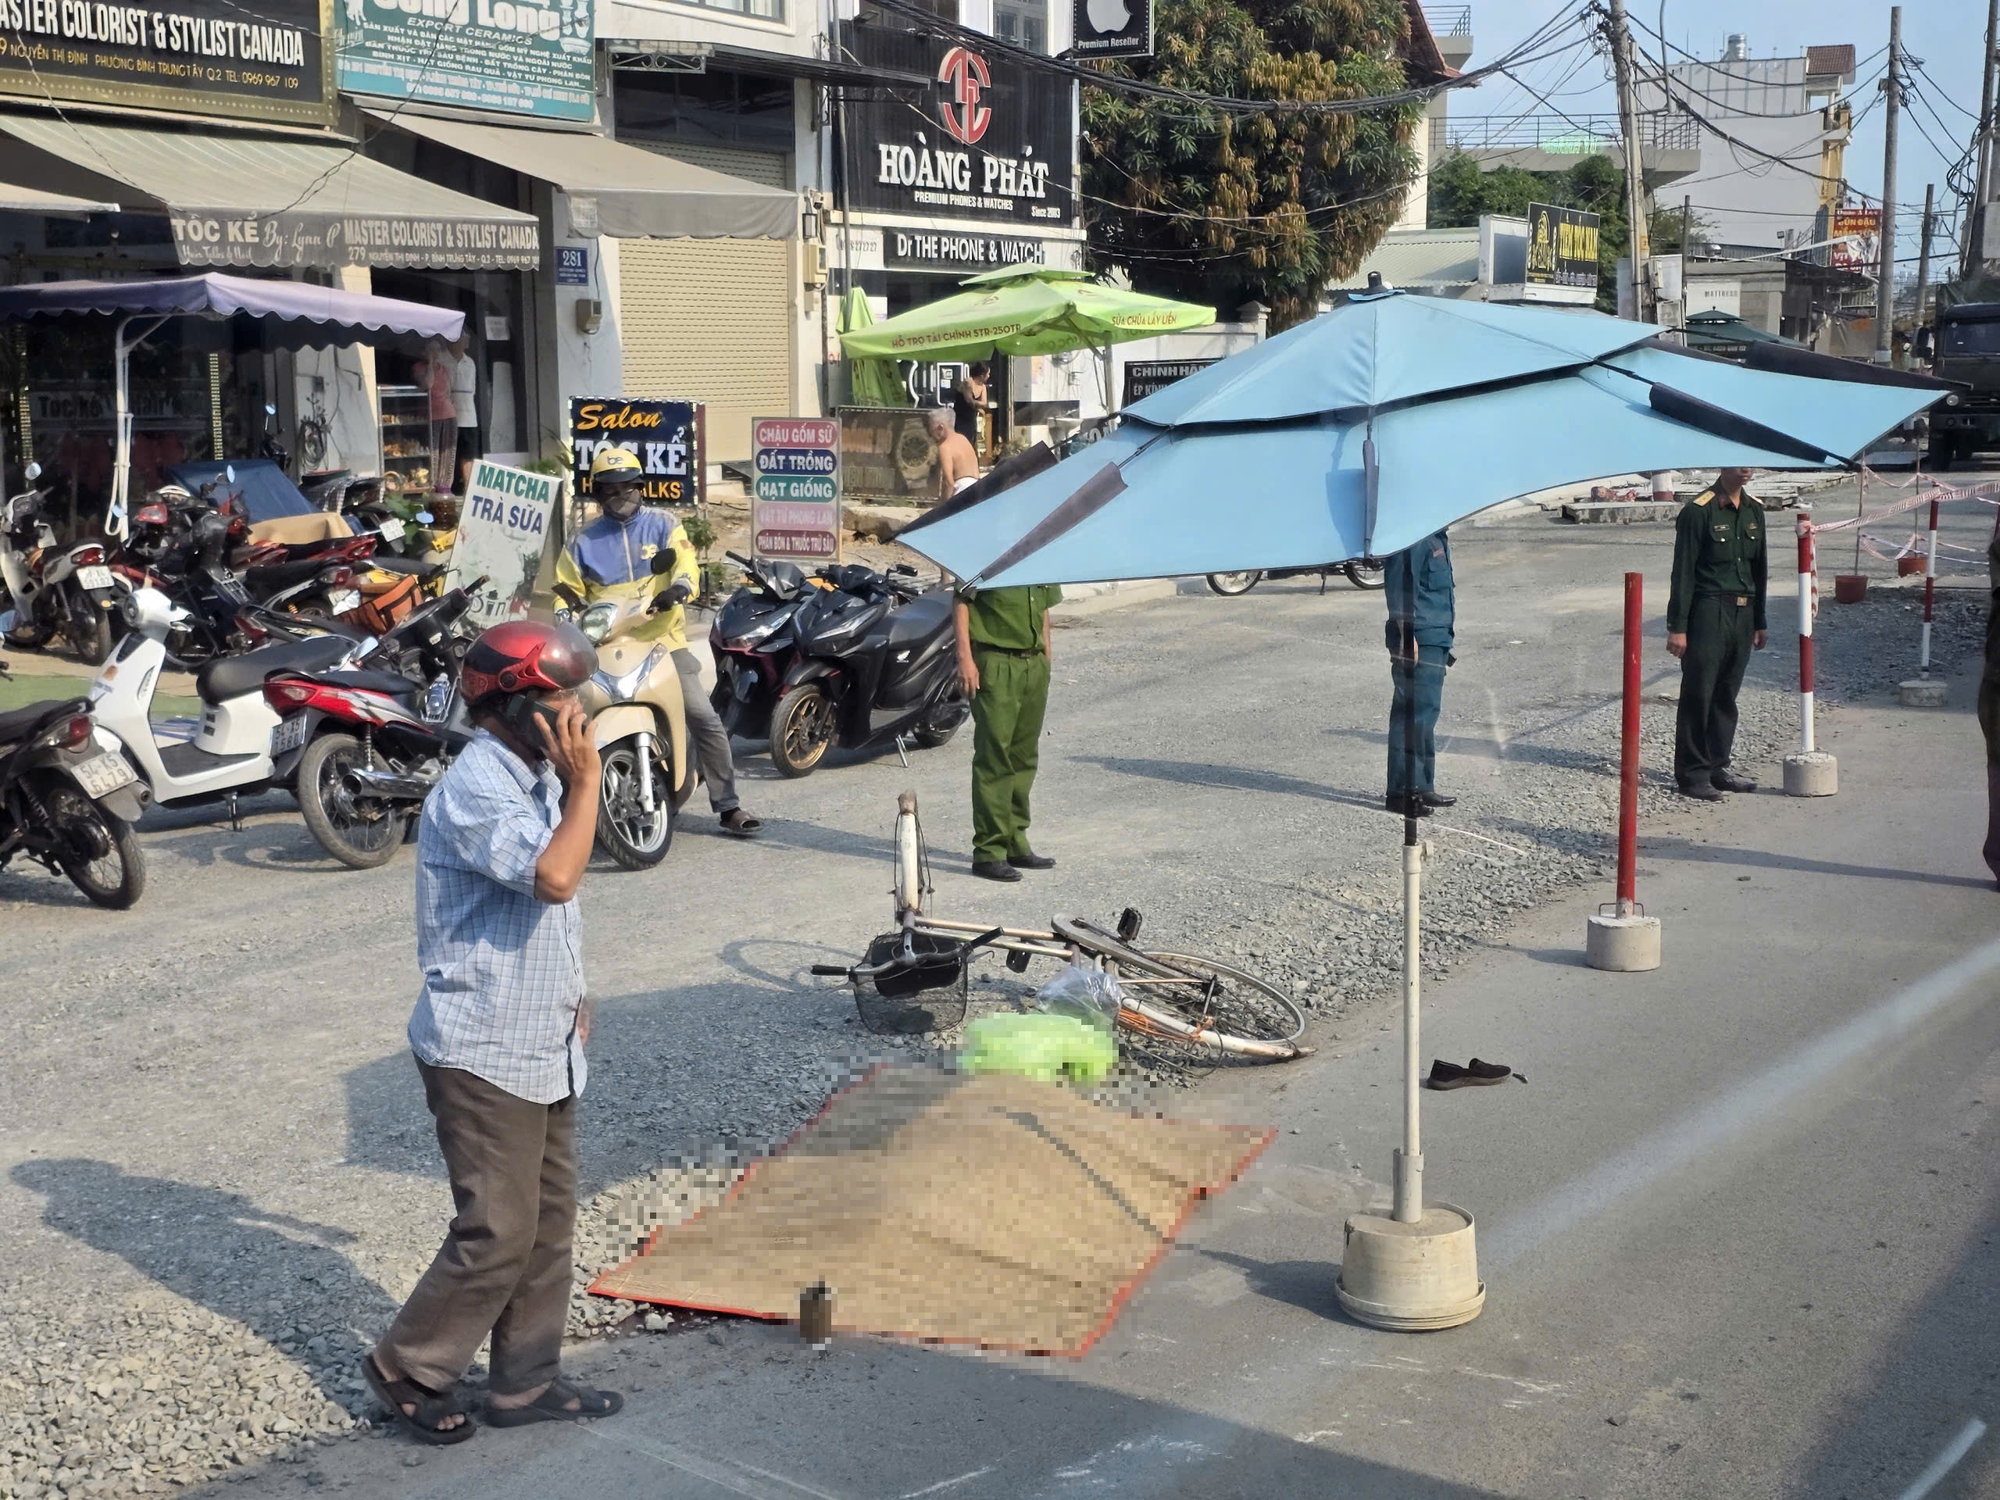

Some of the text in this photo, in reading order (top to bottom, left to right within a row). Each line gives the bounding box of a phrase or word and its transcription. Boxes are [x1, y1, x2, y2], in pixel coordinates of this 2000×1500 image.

[62, 0, 147, 47] COLORIST
[153, 12, 167, 50] &
[169, 14, 236, 57] STYLIST
[240, 24, 304, 66] CANADA
[407, 17, 533, 46] EXPORT CERAMICS
[1078, 36, 1139, 49] Premium Reseller
[242, 72, 263, 85] 0969
[265, 75, 281, 87] 967
[285, 77, 299, 89] 109
[878, 131, 1051, 199] HOÀNG PHÁT
[914, 190, 1014, 211] PREMIUM PHONES & WATCHES
[343, 219, 390, 246] MASTER
[391, 221, 443, 247] COLORIST
[445, 225, 455, 248] &
[457, 223, 497, 249] STYLIST
[499, 225, 539, 250] CANADA
[349, 246, 366, 262] 279
[562, 250, 582, 267] 281
[897, 233, 913, 258] Dr
[914, 235, 940, 259] THE
[941, 237, 986, 261] PHONE
[989, 242, 999, 262] &
[1001, 241, 1042, 265] WATCH
[943, 328, 971, 343] CHÍNH
[1132, 363, 1179, 379] CHÍNH
[577, 404, 662, 431] Salon
[759, 424, 789, 447] CHẬU
[791, 422, 816, 444] GỐM
[818, 424, 835, 444] SỨ
[645, 427, 687, 476] KỂ
[759, 449, 834, 471] ĐẤT TRỒNG
[476, 465, 550, 504] MATCHA
[759, 481, 787, 501] HẠT
[788, 477, 833, 498] GIỐNG
[471, 495, 543, 535] TRÀ SỮA
[789, 509, 815, 525] PHONG
[817, 511, 833, 526] LAN
